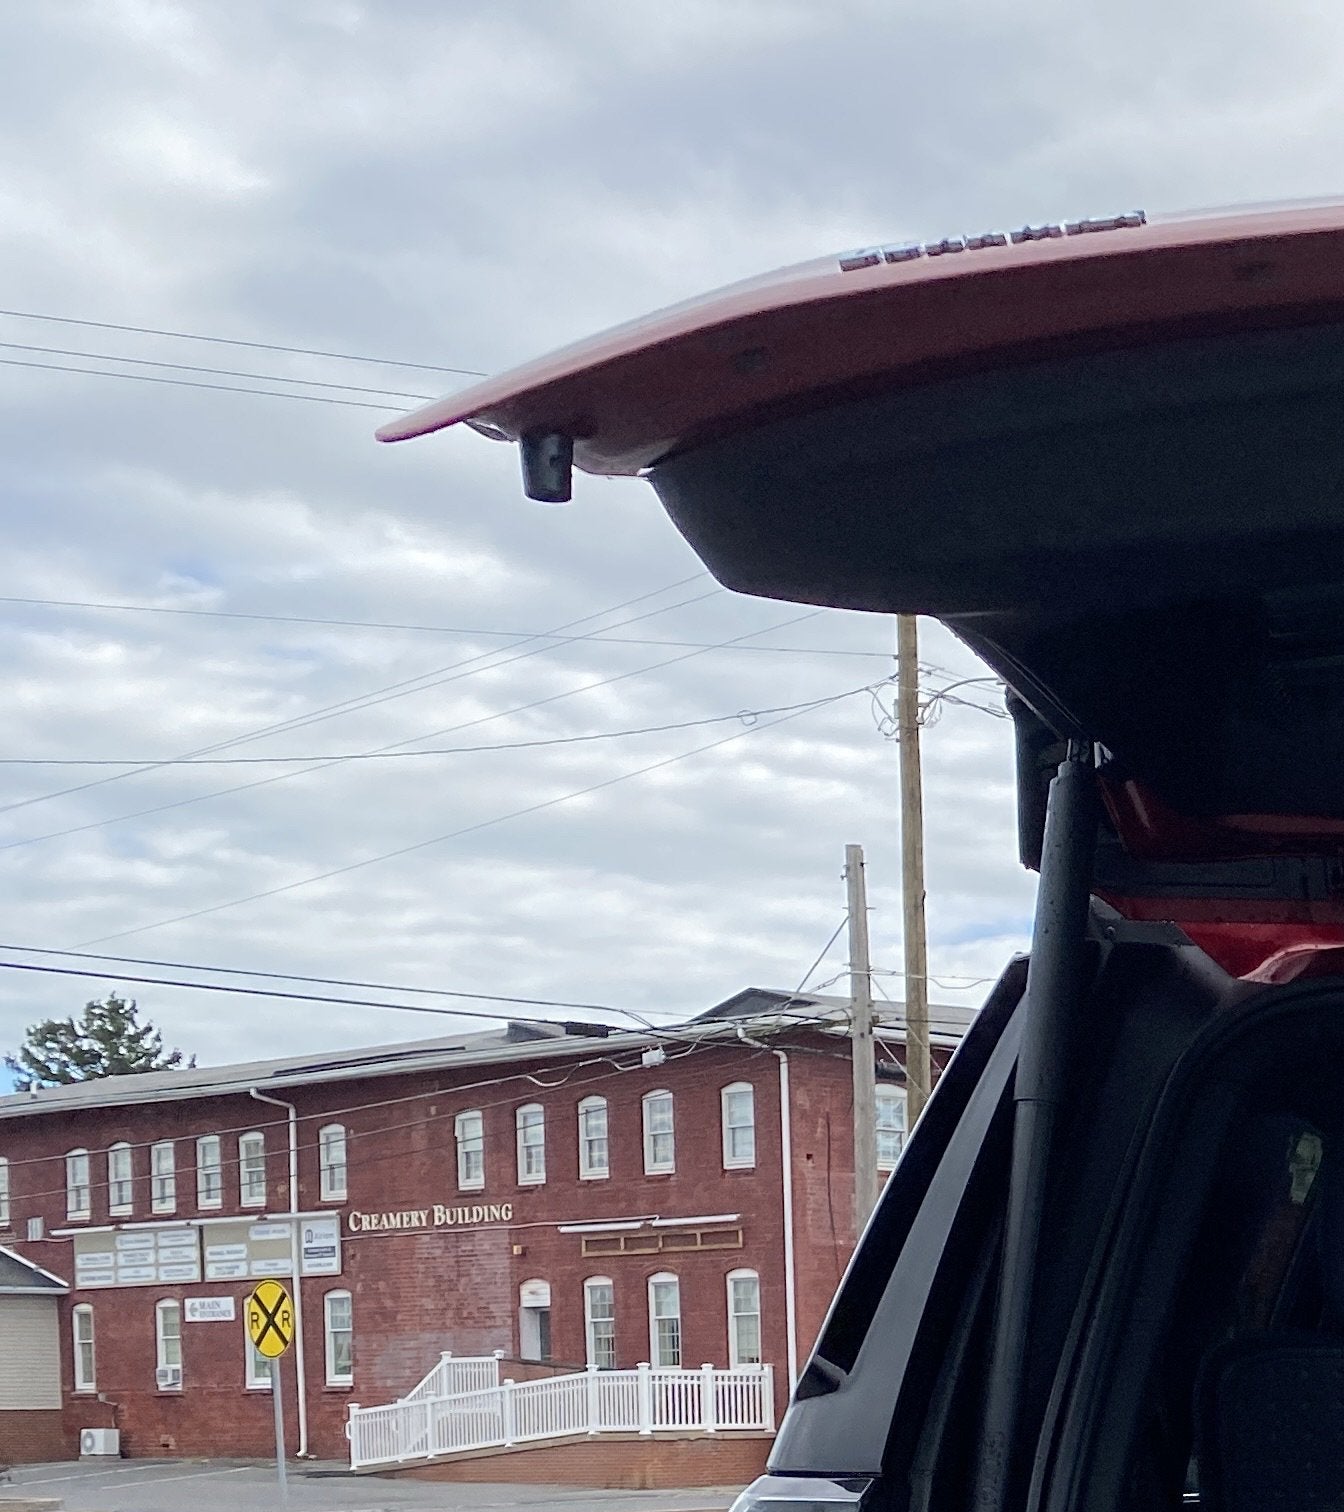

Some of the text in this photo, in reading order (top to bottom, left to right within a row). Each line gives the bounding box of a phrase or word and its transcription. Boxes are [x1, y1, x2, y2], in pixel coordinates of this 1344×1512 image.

[349, 1203, 513, 1232] CREAMERY BUILDING
[199, 1300, 221, 1310] MAIN
[199, 1309, 232, 1318] ENTRANCE
[251, 1310, 291, 1329] R R
